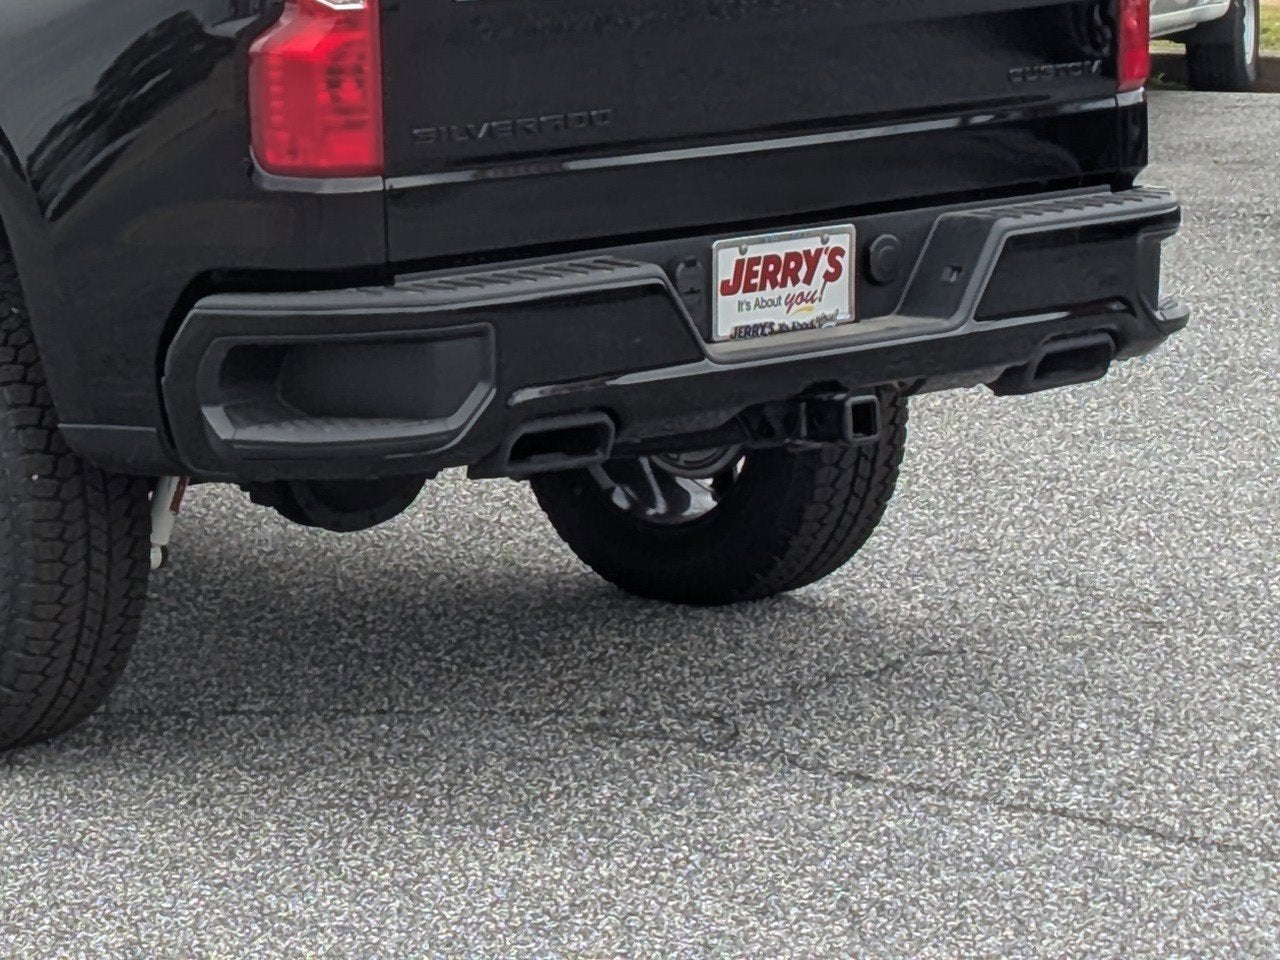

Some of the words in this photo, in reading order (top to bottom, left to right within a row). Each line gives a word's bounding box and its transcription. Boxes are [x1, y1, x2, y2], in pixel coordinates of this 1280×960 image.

[412, 108, 612, 144] SILVERADO
[720, 246, 846, 297] JERRY'S
[737, 297, 751, 313] It's
[753, 295, 782, 310] About
